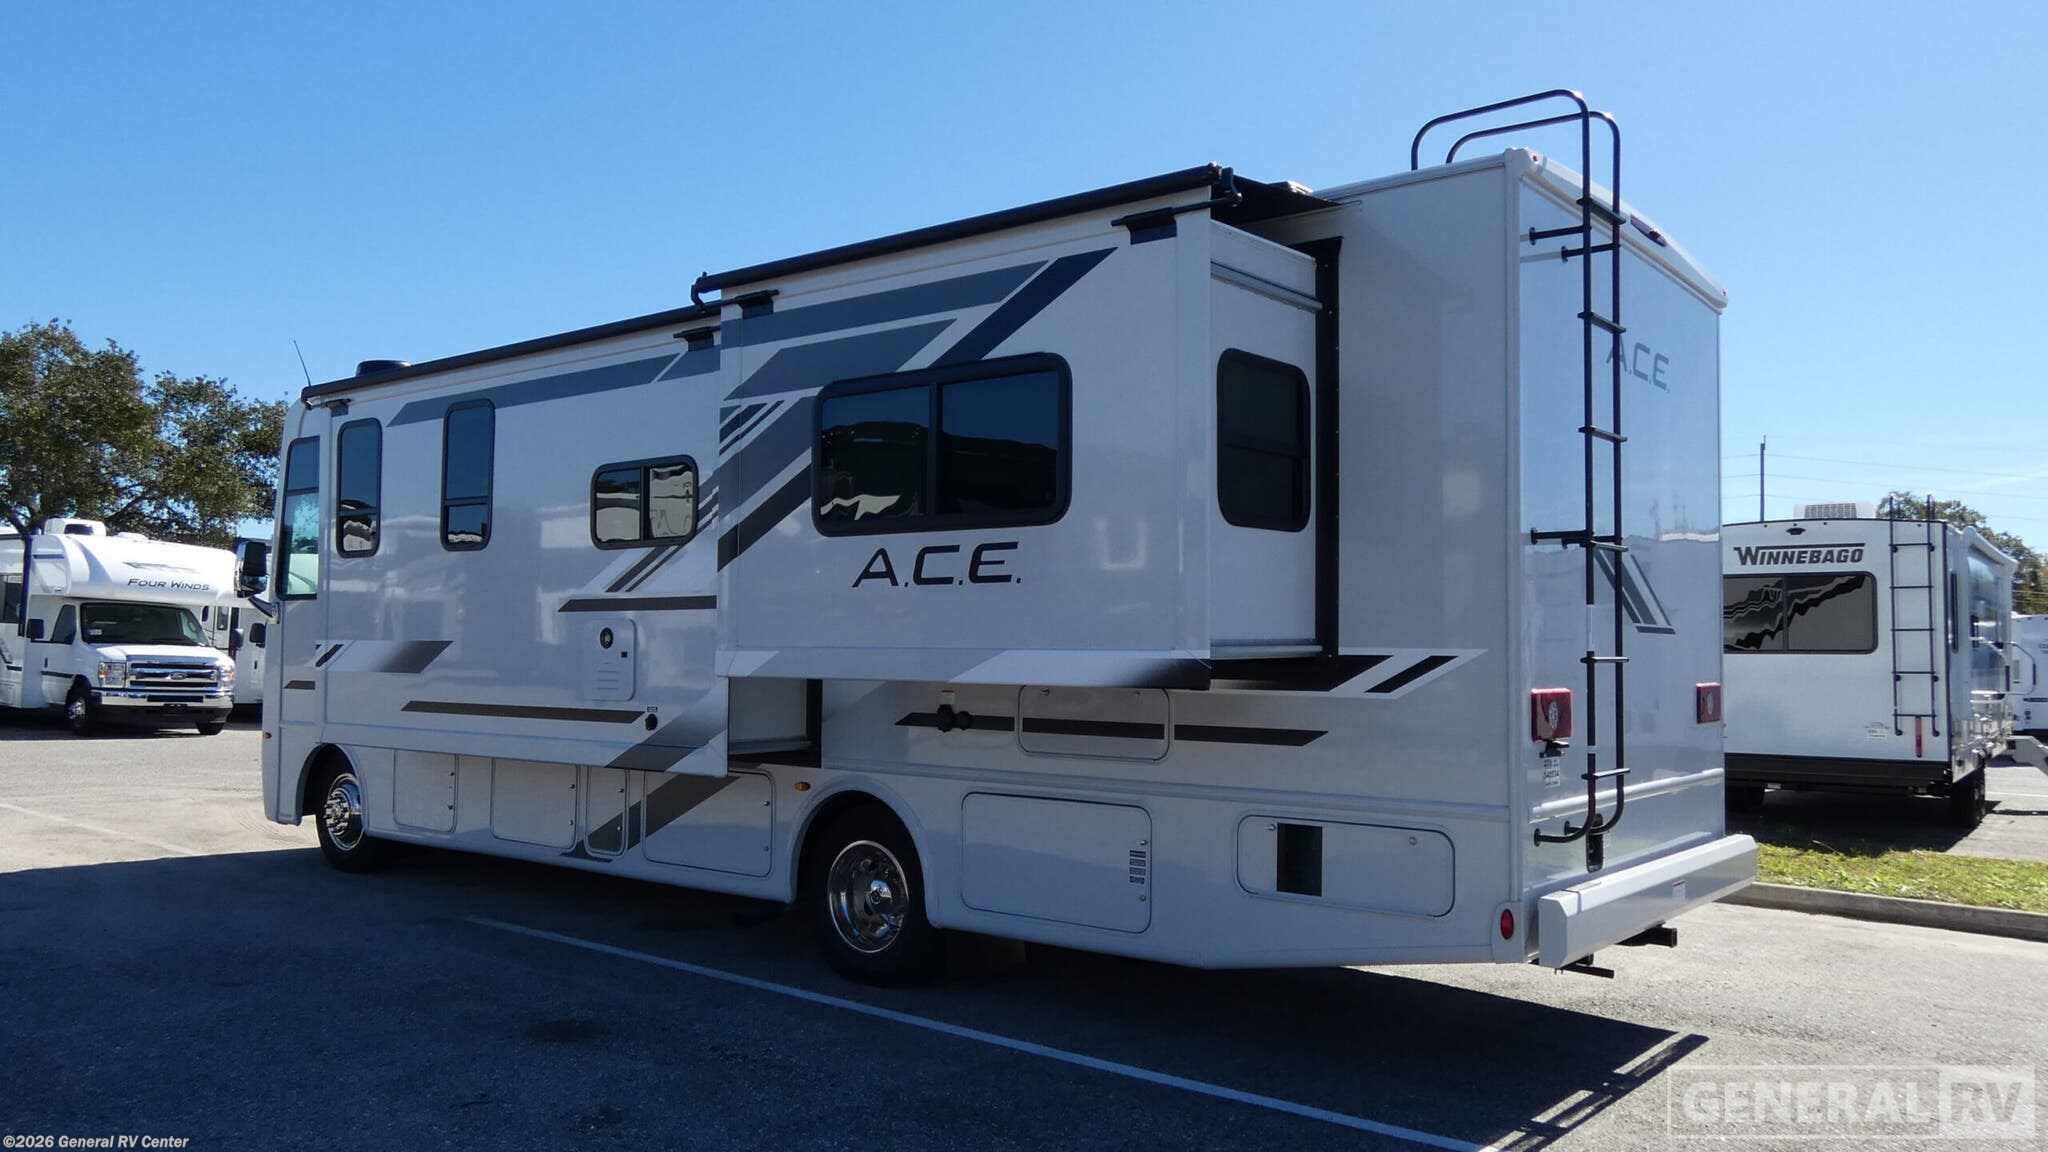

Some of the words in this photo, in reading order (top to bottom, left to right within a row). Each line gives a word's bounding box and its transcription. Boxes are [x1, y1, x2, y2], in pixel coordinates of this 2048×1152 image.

[851, 541, 1022, 588] A.C.E.
[1733, 543, 1866, 566] WINNEBAGO
[127, 578, 167, 588] FOUR
[170, 580, 210, 591] WINDS
